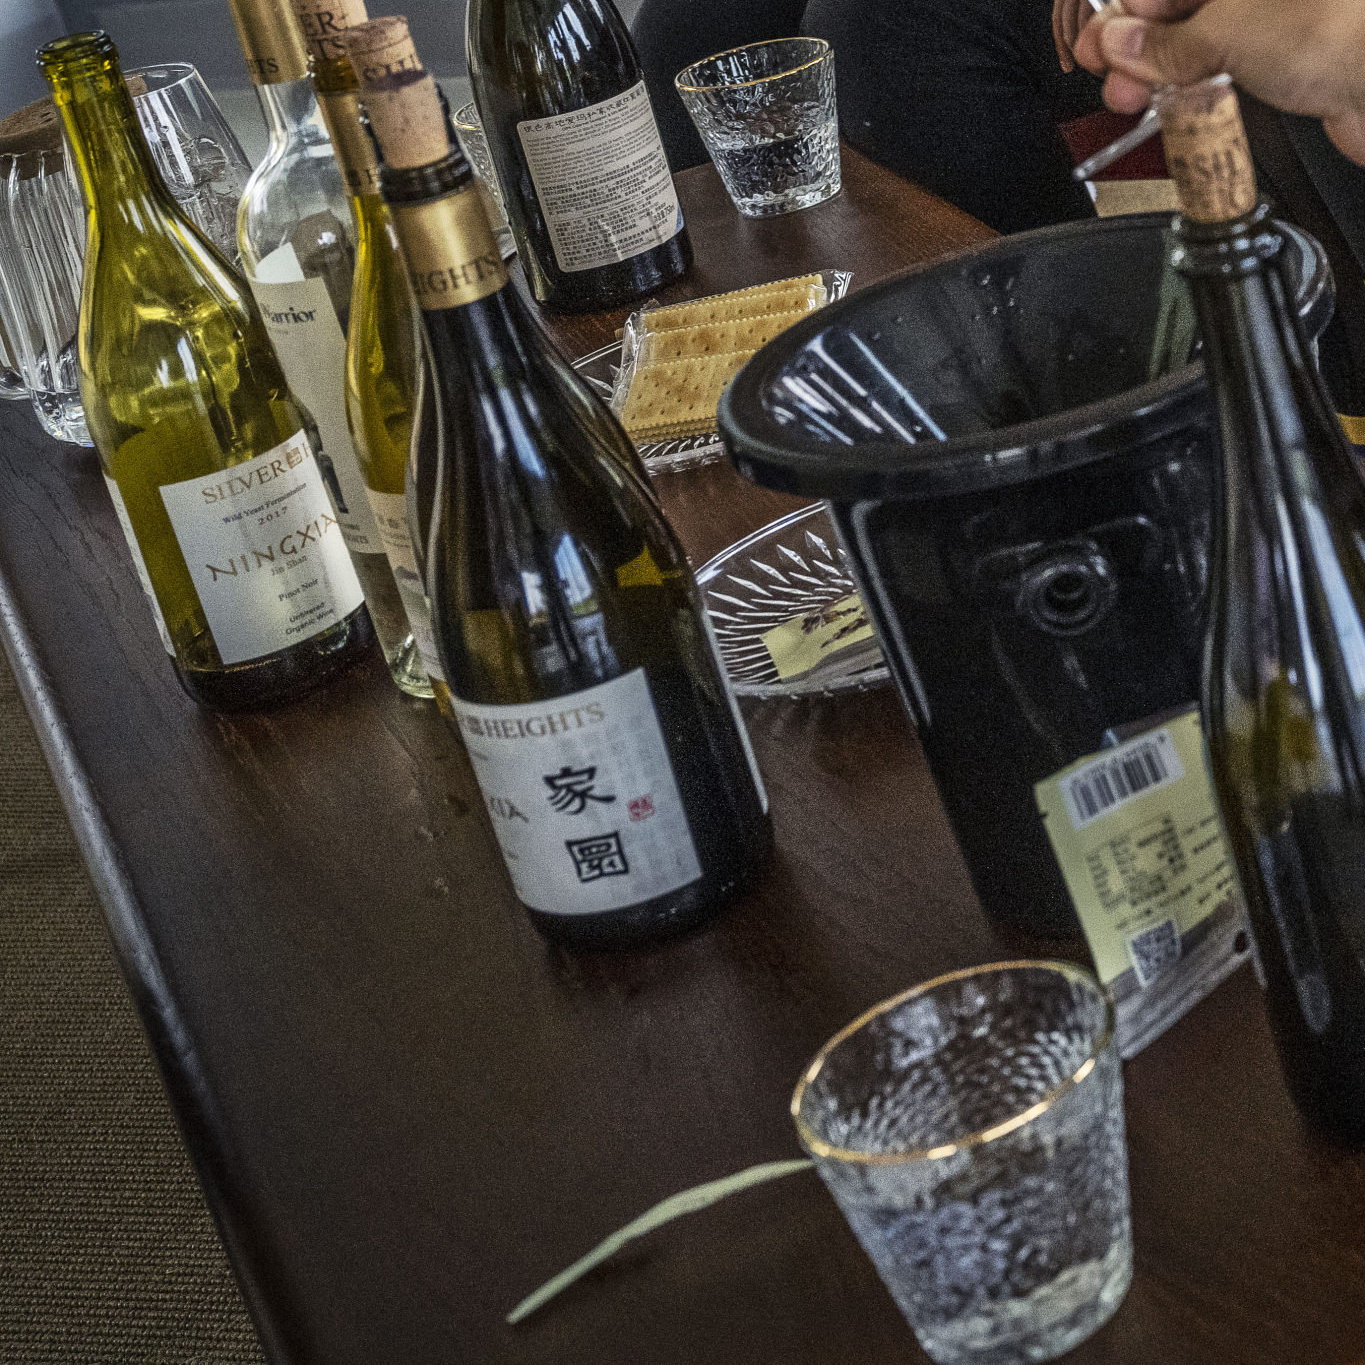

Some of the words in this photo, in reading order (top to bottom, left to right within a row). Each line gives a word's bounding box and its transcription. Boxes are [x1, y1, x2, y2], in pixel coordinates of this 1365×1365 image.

[201, 458, 287, 504] SILVER
[222, 511, 242, 525] Wild
[243, 503, 264, 519] Yeast
[257, 506, 289, 526] 2017
[205, 513, 338, 582] NINGXIA
[278, 587, 300, 602] Pinot
[300, 578, 319, 593] Noir
[285, 616, 314, 636] Organic
[484, 702, 606, 740] HEIGHTS
